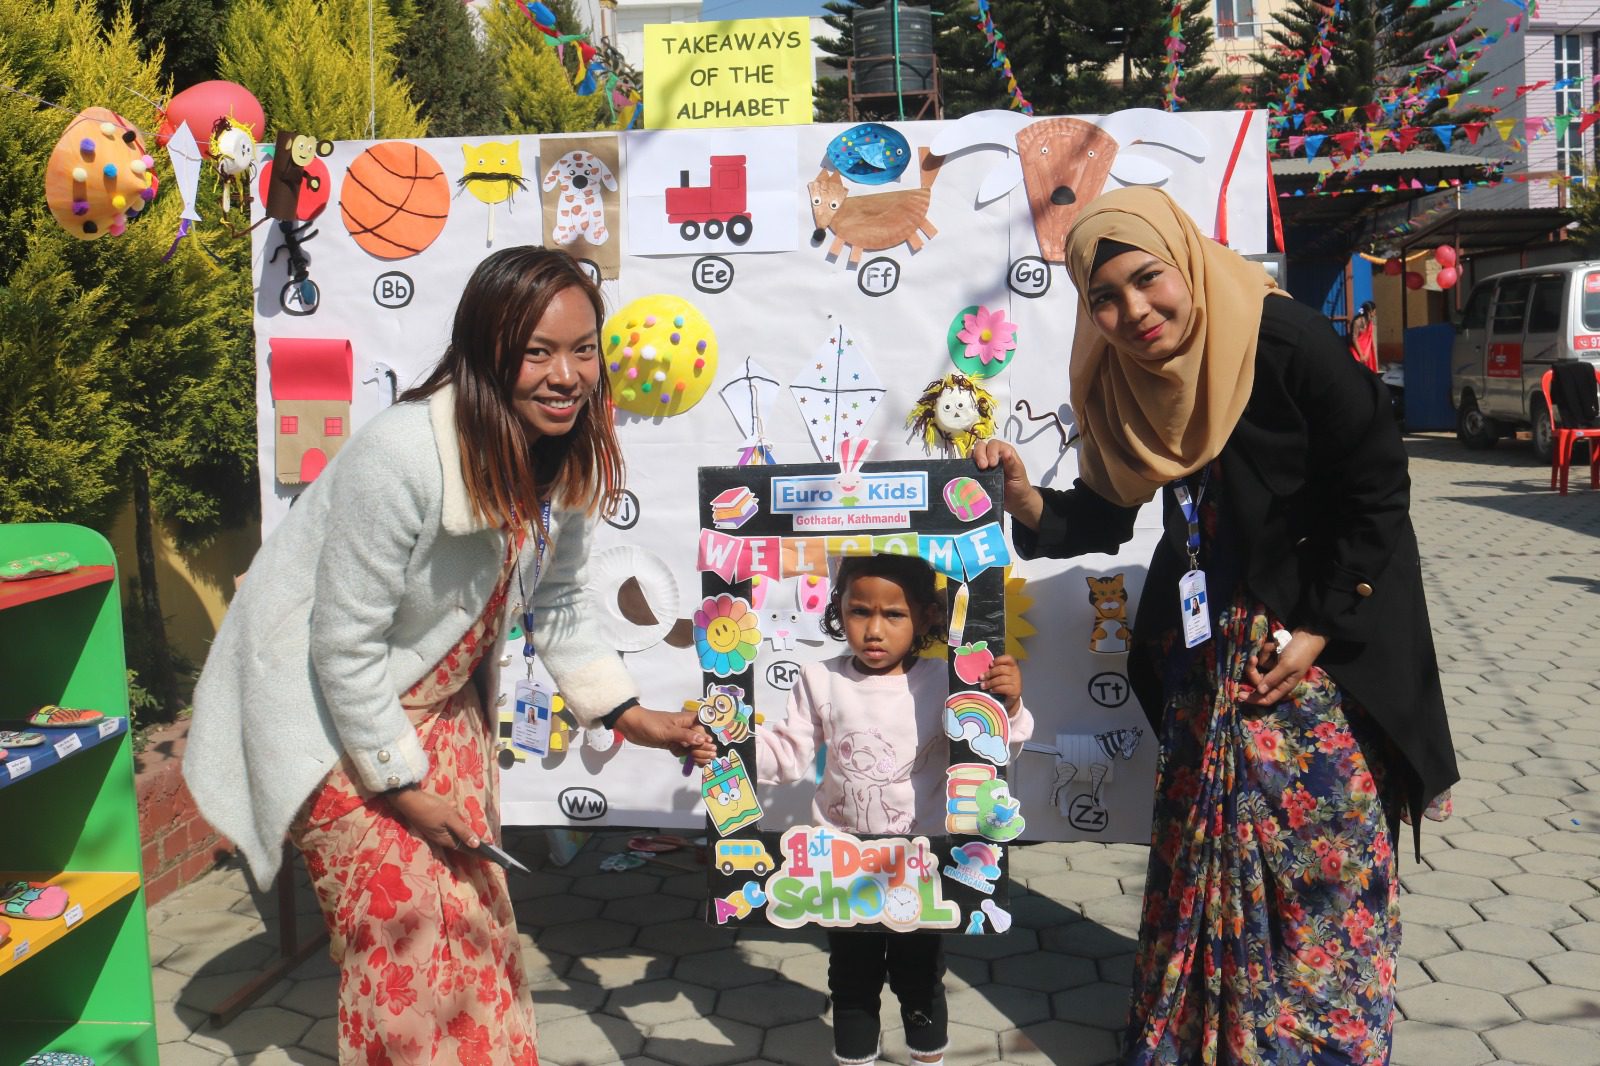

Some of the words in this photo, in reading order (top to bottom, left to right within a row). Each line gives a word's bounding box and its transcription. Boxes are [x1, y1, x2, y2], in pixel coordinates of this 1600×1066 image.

[661, 31, 801, 55] TAKEAWAYS
[690, 67, 719, 86] OF
[728, 64, 774, 84] THE
[676, 97, 790, 120] ALPHABET
[701, 263, 727, 283] Ee
[866, 267, 893, 288] Ff
[1015, 262, 1045, 287] Gg
[382, 280, 407, 298] Bb
[782, 486, 833, 503] Euro
[868, 483, 918, 500] Kids
[796, 513, 844, 526] Gothatar,
[847, 512, 907, 524] Kathmandu
[773, 665, 799, 683] Rr
[1094, 683, 1122, 700] Tt
[565, 795, 603, 813] Ww
[1075, 804, 1104, 824] Zz
[787, 829, 834, 878] 1st
[831, 839, 905, 886] Day
[907, 843, 931, 883] of
